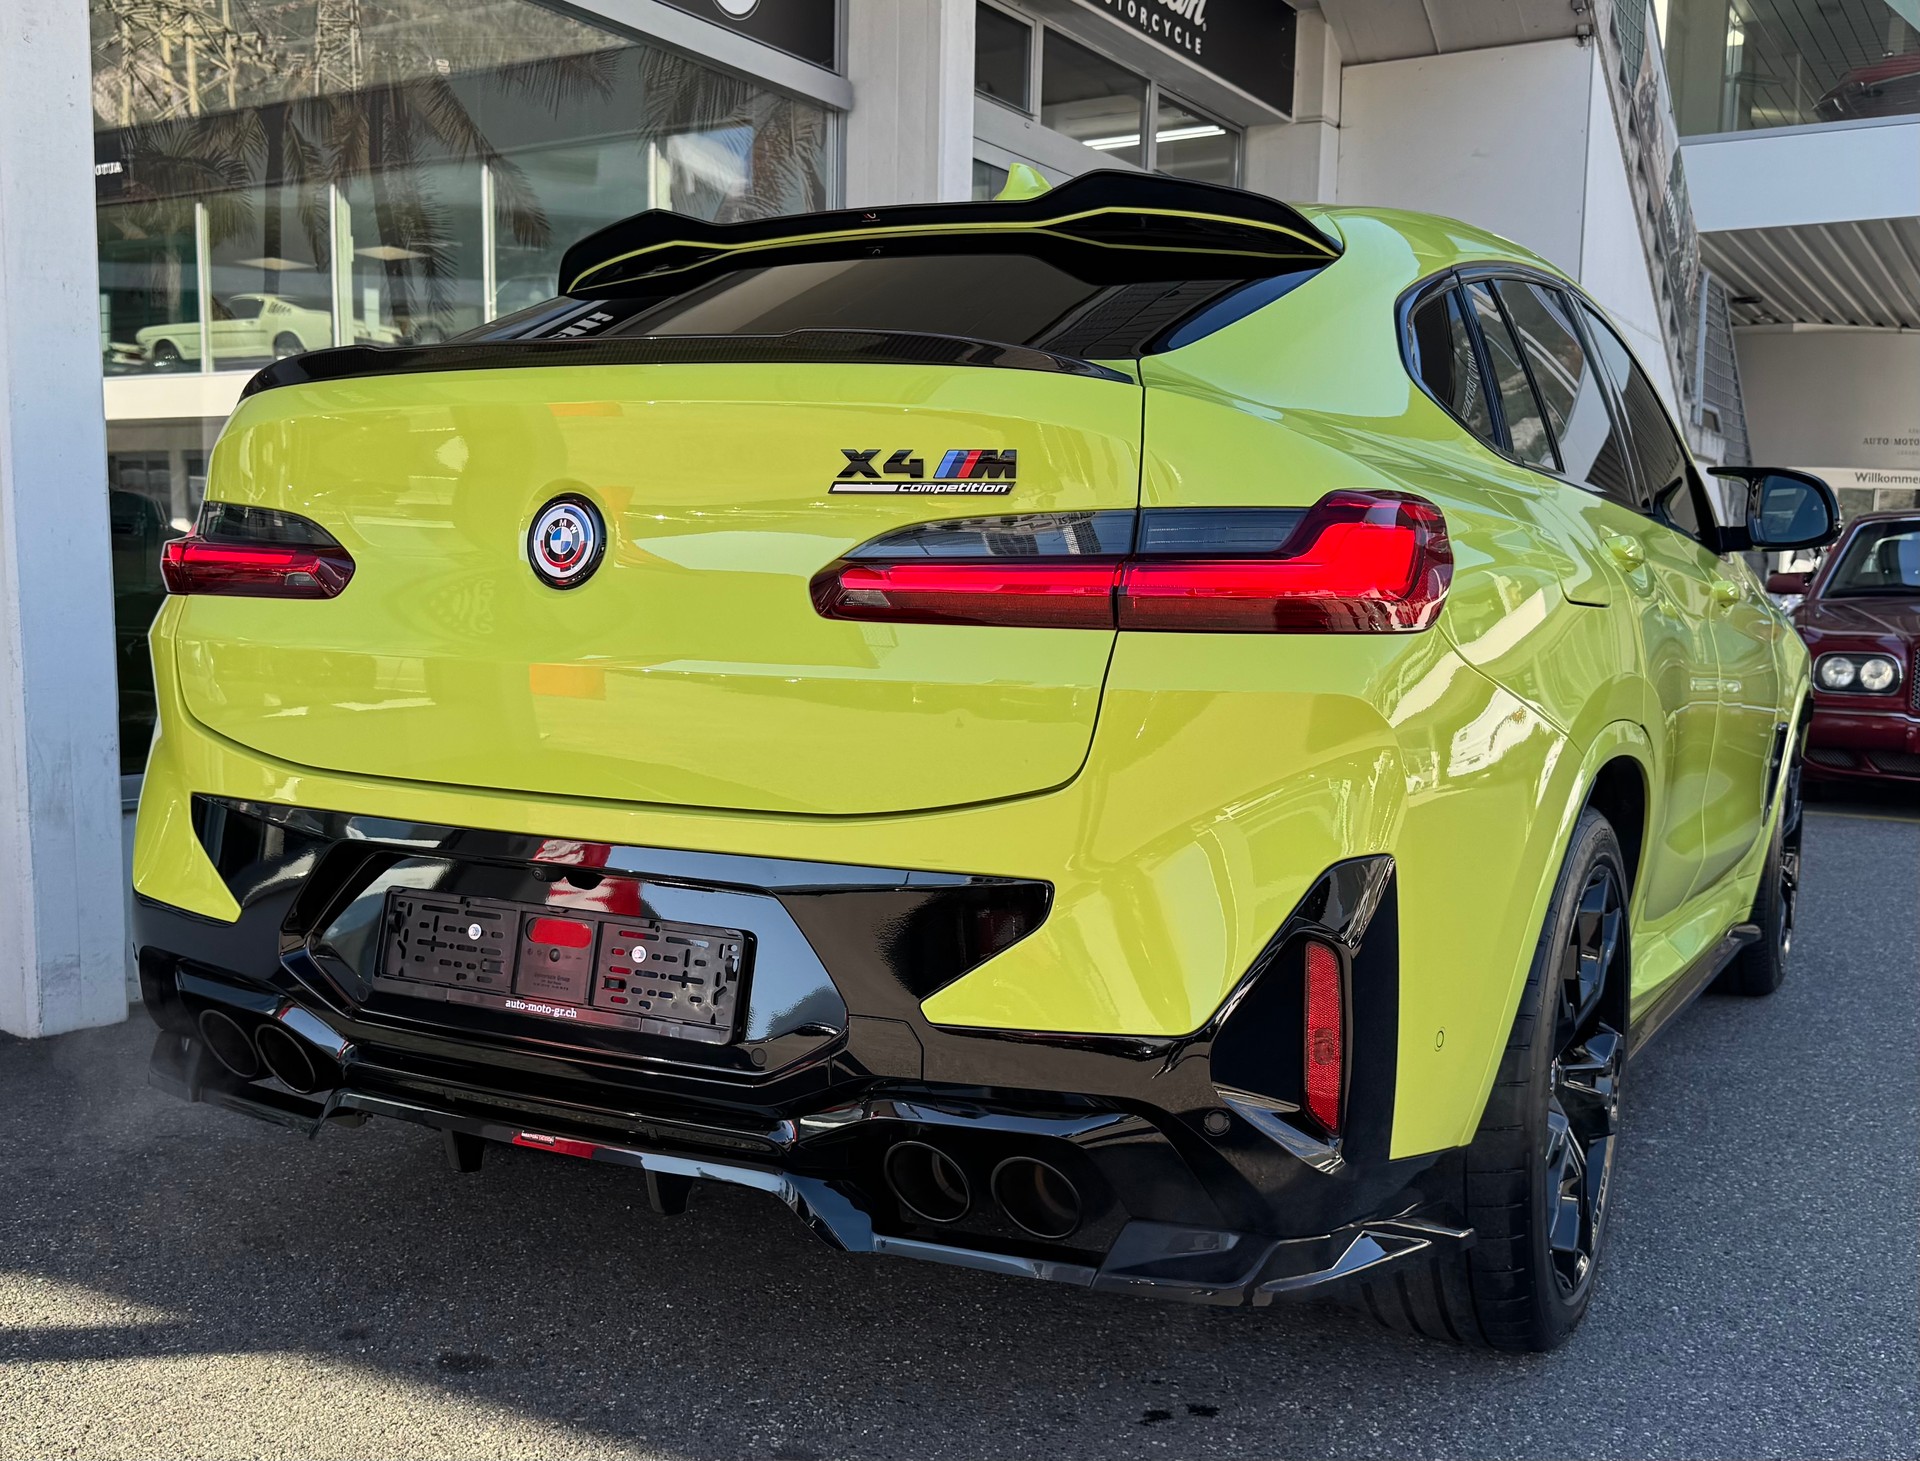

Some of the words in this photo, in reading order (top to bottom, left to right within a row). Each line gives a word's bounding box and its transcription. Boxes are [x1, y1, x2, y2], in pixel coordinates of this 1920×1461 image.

[1862, 437, 1889, 445] AUTO
[1893, 438, 1920, 446] MOTO
[836, 449, 924, 478] X4
[1855, 472, 1920, 484] Willkomme
[898, 482, 1008, 494] competition
[548, 519, 578, 534] BMW
[505, 1000, 577, 1018] auto-moto-gr.ch
